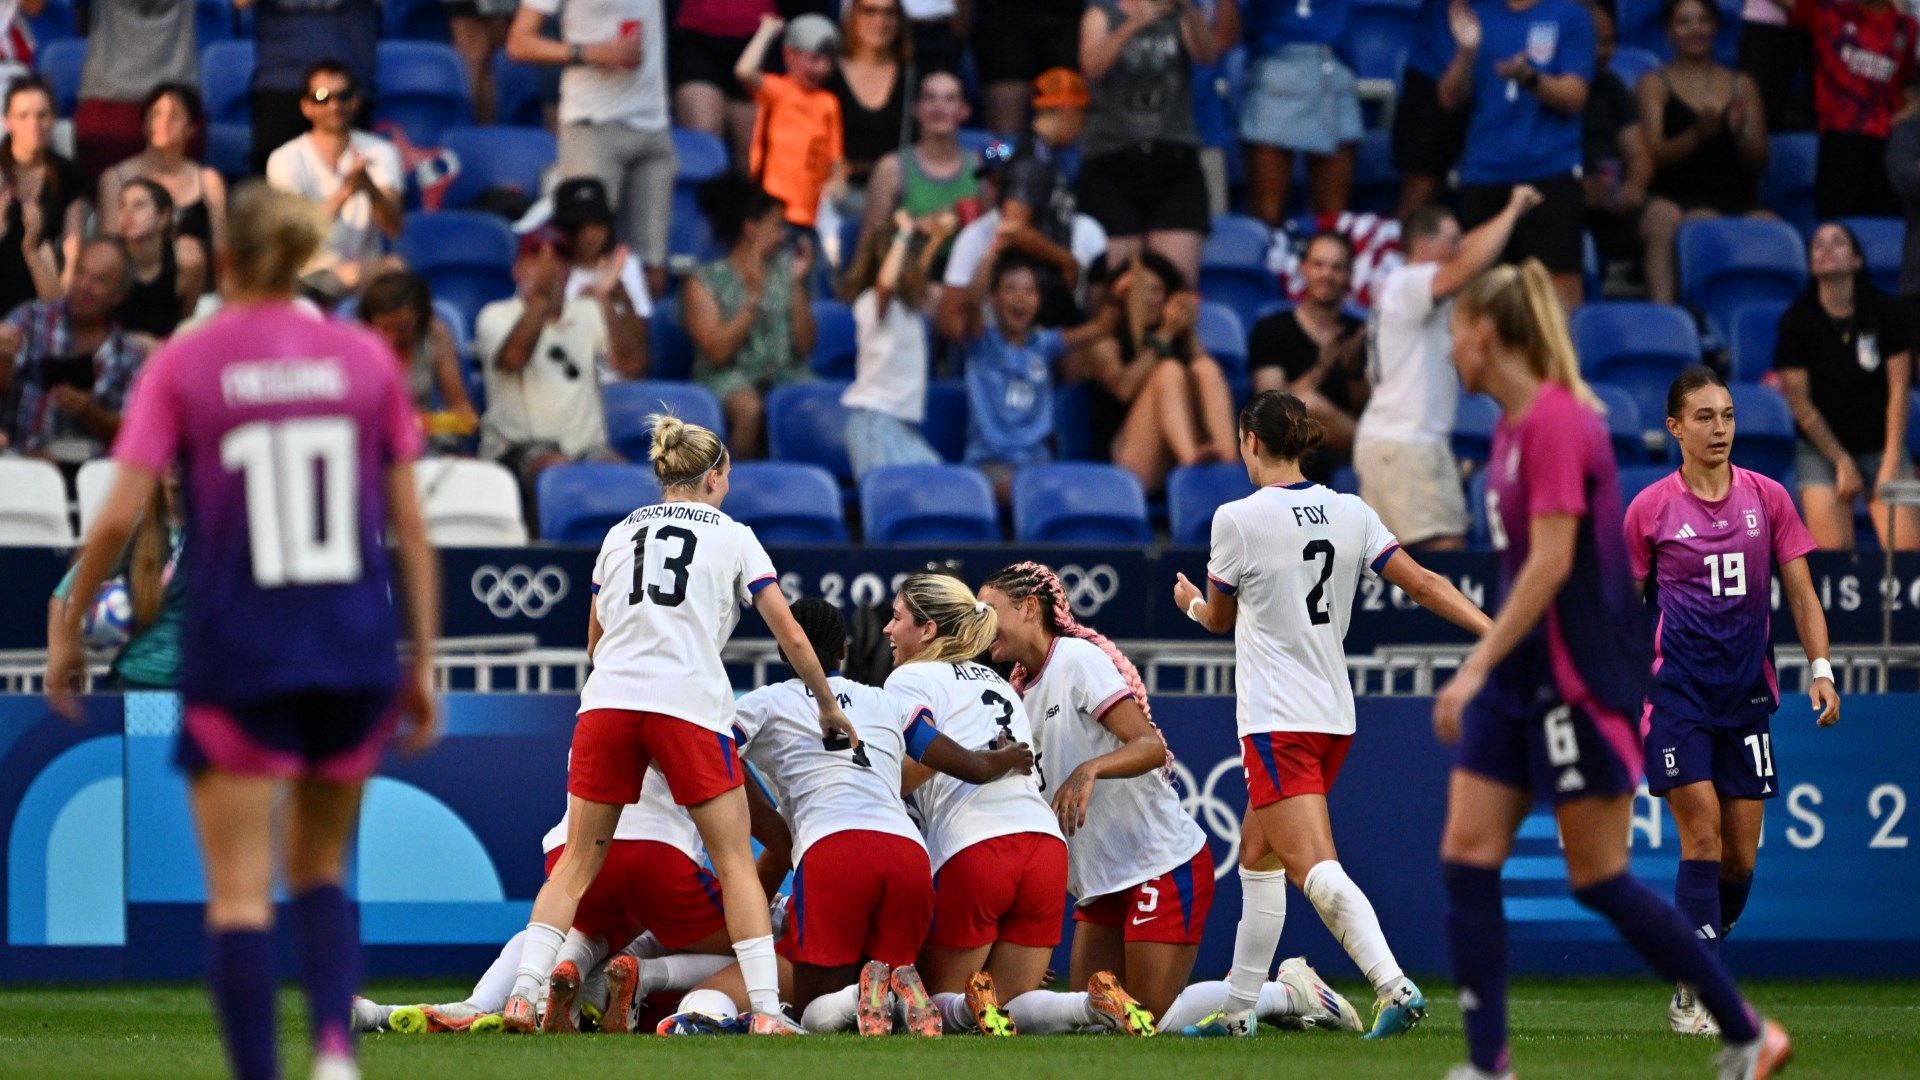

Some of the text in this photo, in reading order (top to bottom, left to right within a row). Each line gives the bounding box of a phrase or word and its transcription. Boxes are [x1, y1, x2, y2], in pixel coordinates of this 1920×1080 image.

[219, 417, 361, 586] 10
[624, 506, 720, 525] NIGHSWONGER
[1292, 505, 1329, 527] FOX
[1746, 514, 1757, 528] D
[628, 525, 698, 607] 13
[1303, 539, 1335, 625] 2
[1704, 552, 1746, 596] 19
[952, 663, 1007, 686] ALBER
[981, 689, 1017, 750] 3
[1544, 706, 1580, 767] 6
[1665, 753, 1676, 769] D
[1137, 877, 1160, 912] 5
